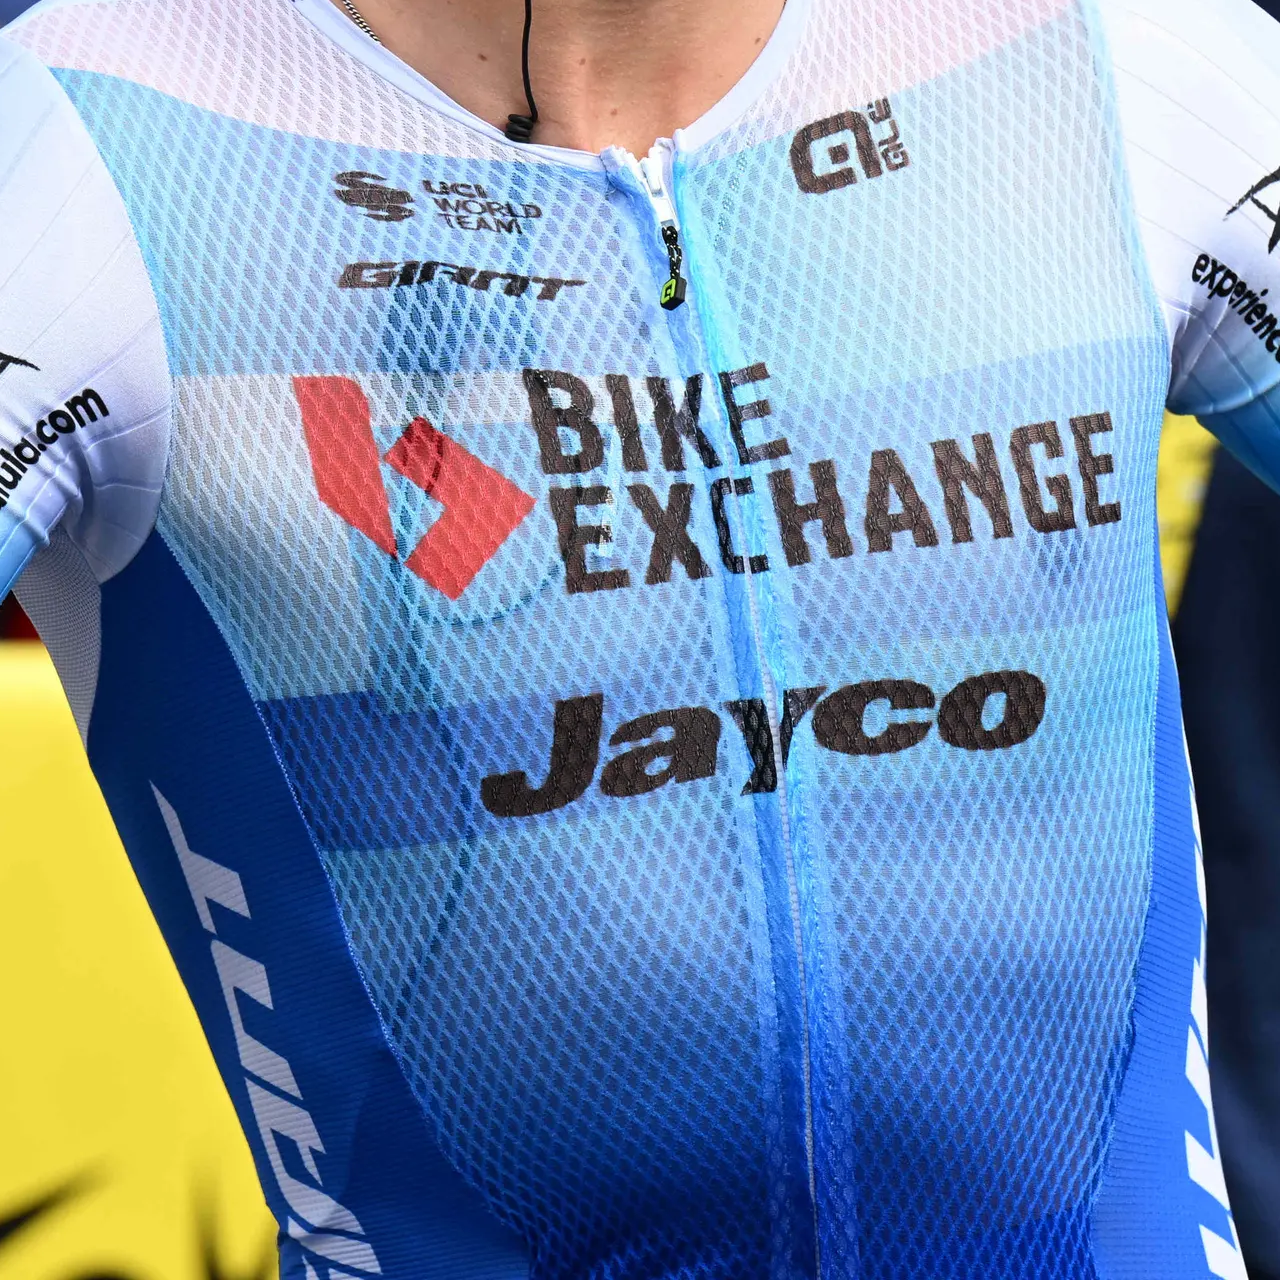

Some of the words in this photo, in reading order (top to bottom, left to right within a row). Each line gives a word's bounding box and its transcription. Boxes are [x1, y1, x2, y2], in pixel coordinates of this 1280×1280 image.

[422, 179, 489, 199] UCI
[432, 197, 543, 219] WORLD
[437, 212, 524, 234] TEAM
[337, 260, 588, 301] GIANT
[521, 361, 790, 476] BIKE
[548, 411, 1122, 594] EXCHANGE
[479, 669, 1047, 818] Jayco
[149, 779, 385, 1280] IANT
